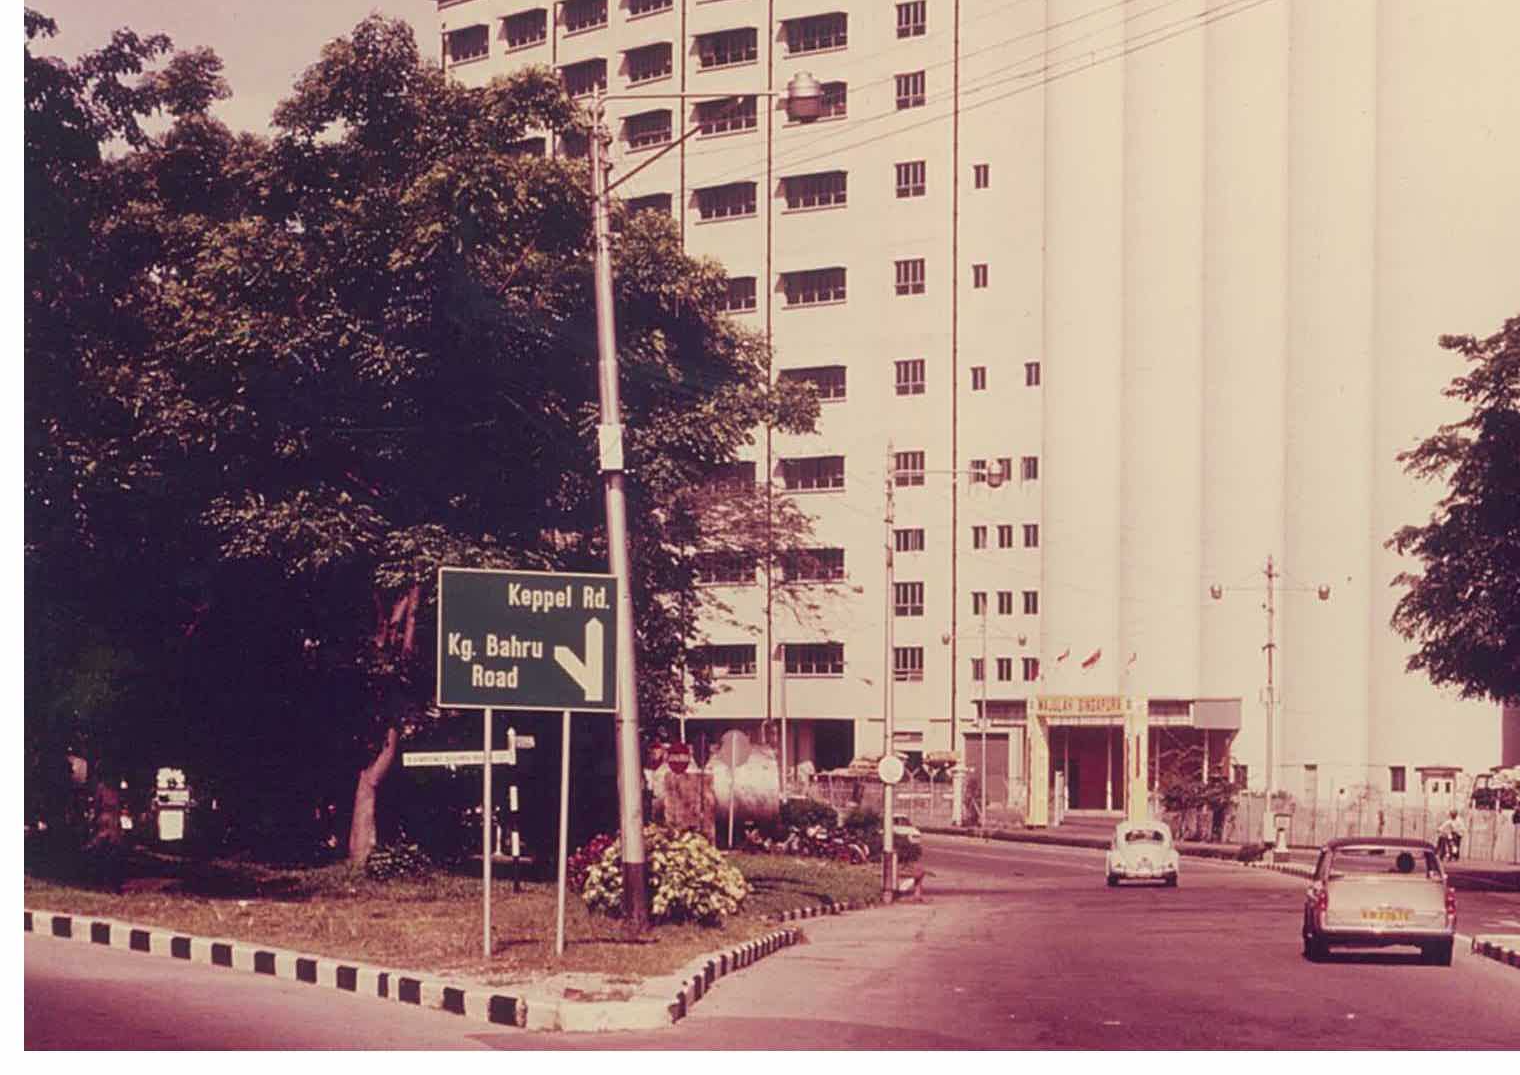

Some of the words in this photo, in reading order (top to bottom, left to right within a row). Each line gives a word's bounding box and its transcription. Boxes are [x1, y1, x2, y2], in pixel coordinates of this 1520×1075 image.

[508, 582, 572, 613] Keppel
[582, 585, 610, 609] Rd.
[448, 632, 477, 661] Kg.
[485, 634, 543, 658] Bahru
[471, 664, 519, 688] Road
